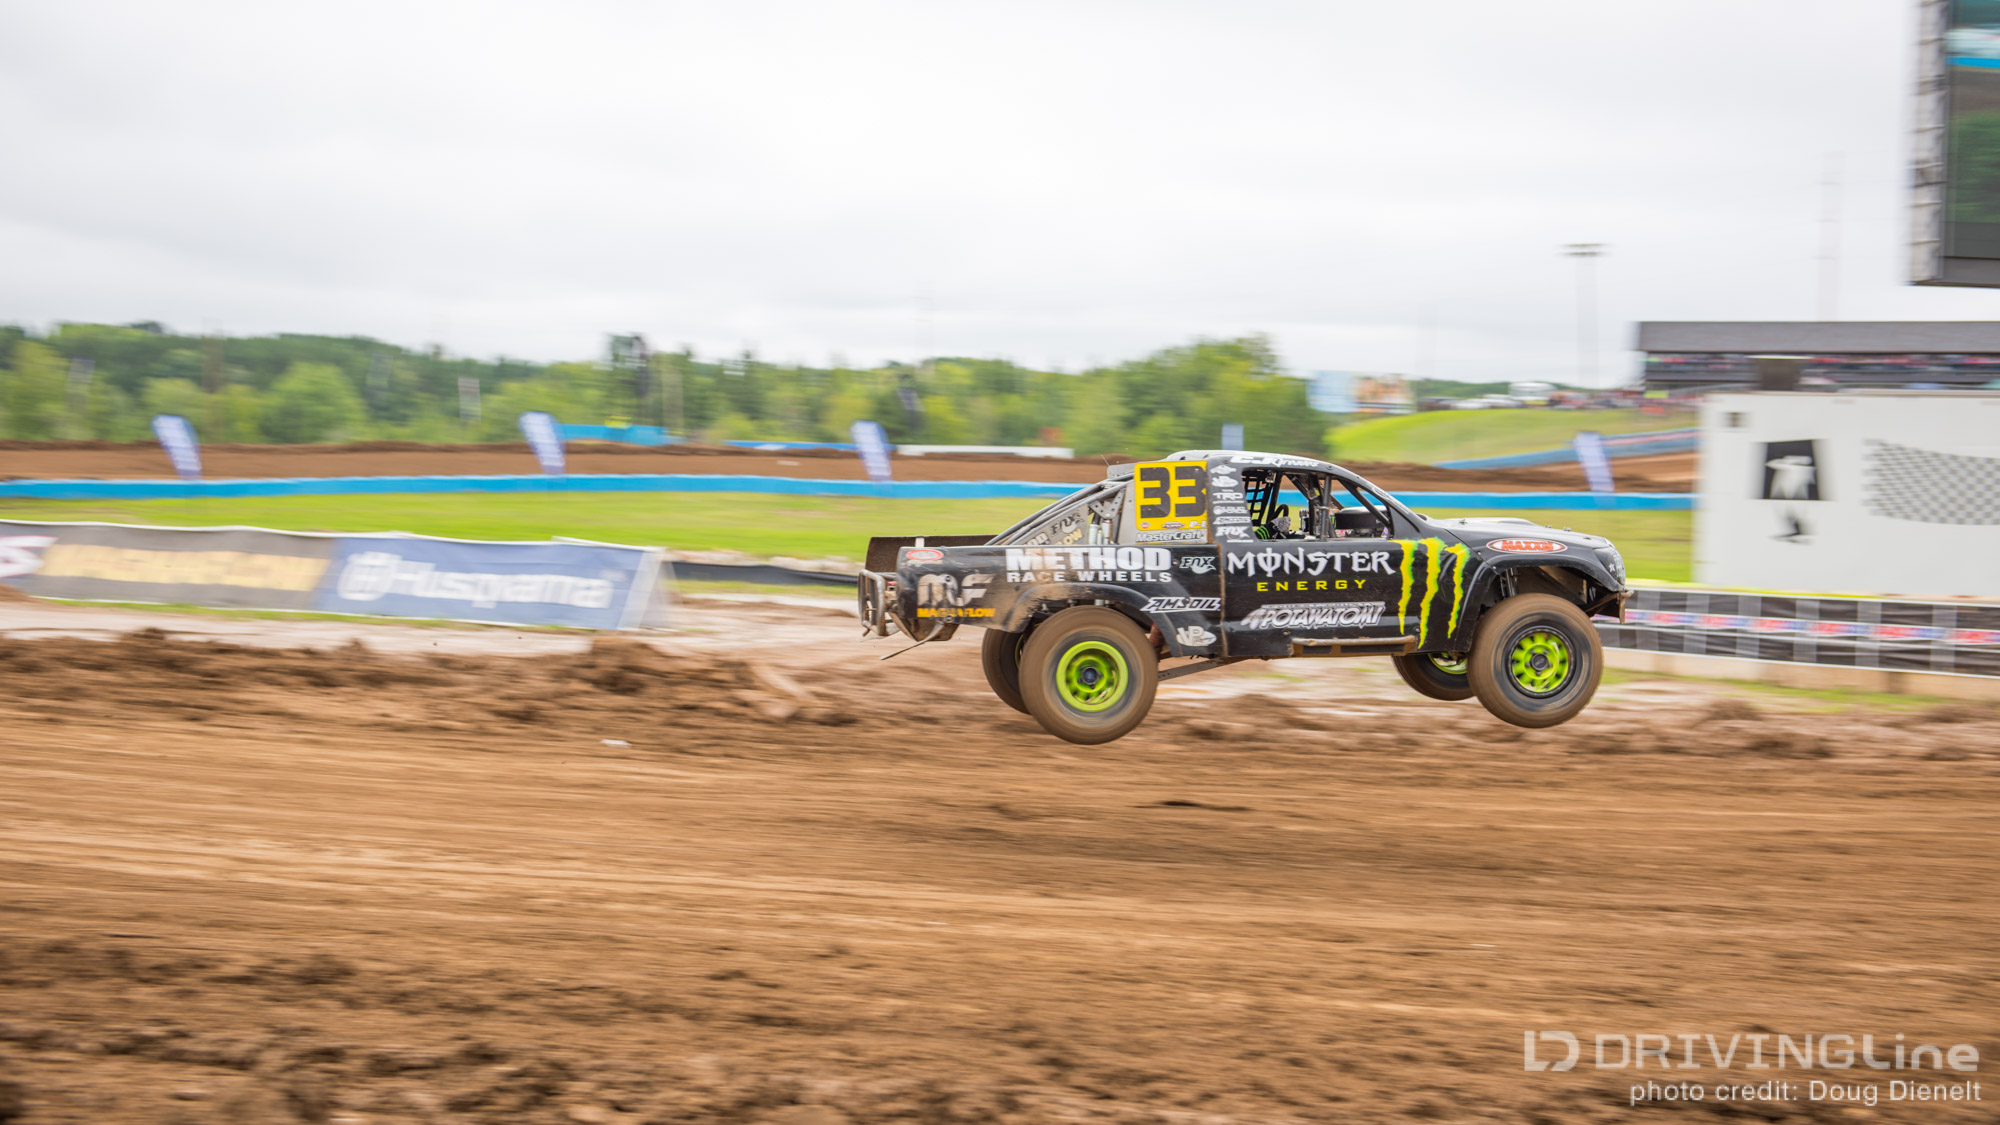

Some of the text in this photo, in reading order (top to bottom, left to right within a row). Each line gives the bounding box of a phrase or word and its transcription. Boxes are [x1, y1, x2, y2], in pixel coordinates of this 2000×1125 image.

[1140, 466, 1206, 518] 33
[1501, 540, 1554, 551] MAXXIS
[1006, 547, 1171, 571] METHOD
[1179, 556, 1216, 574] FOX
[1227, 547, 1396, 577] MONSTER
[1007, 571, 1172, 583] RACE WHEELS
[1256, 579, 1366, 592] ENERGY
[1258, 607, 1386, 629] POTAWATOMI
